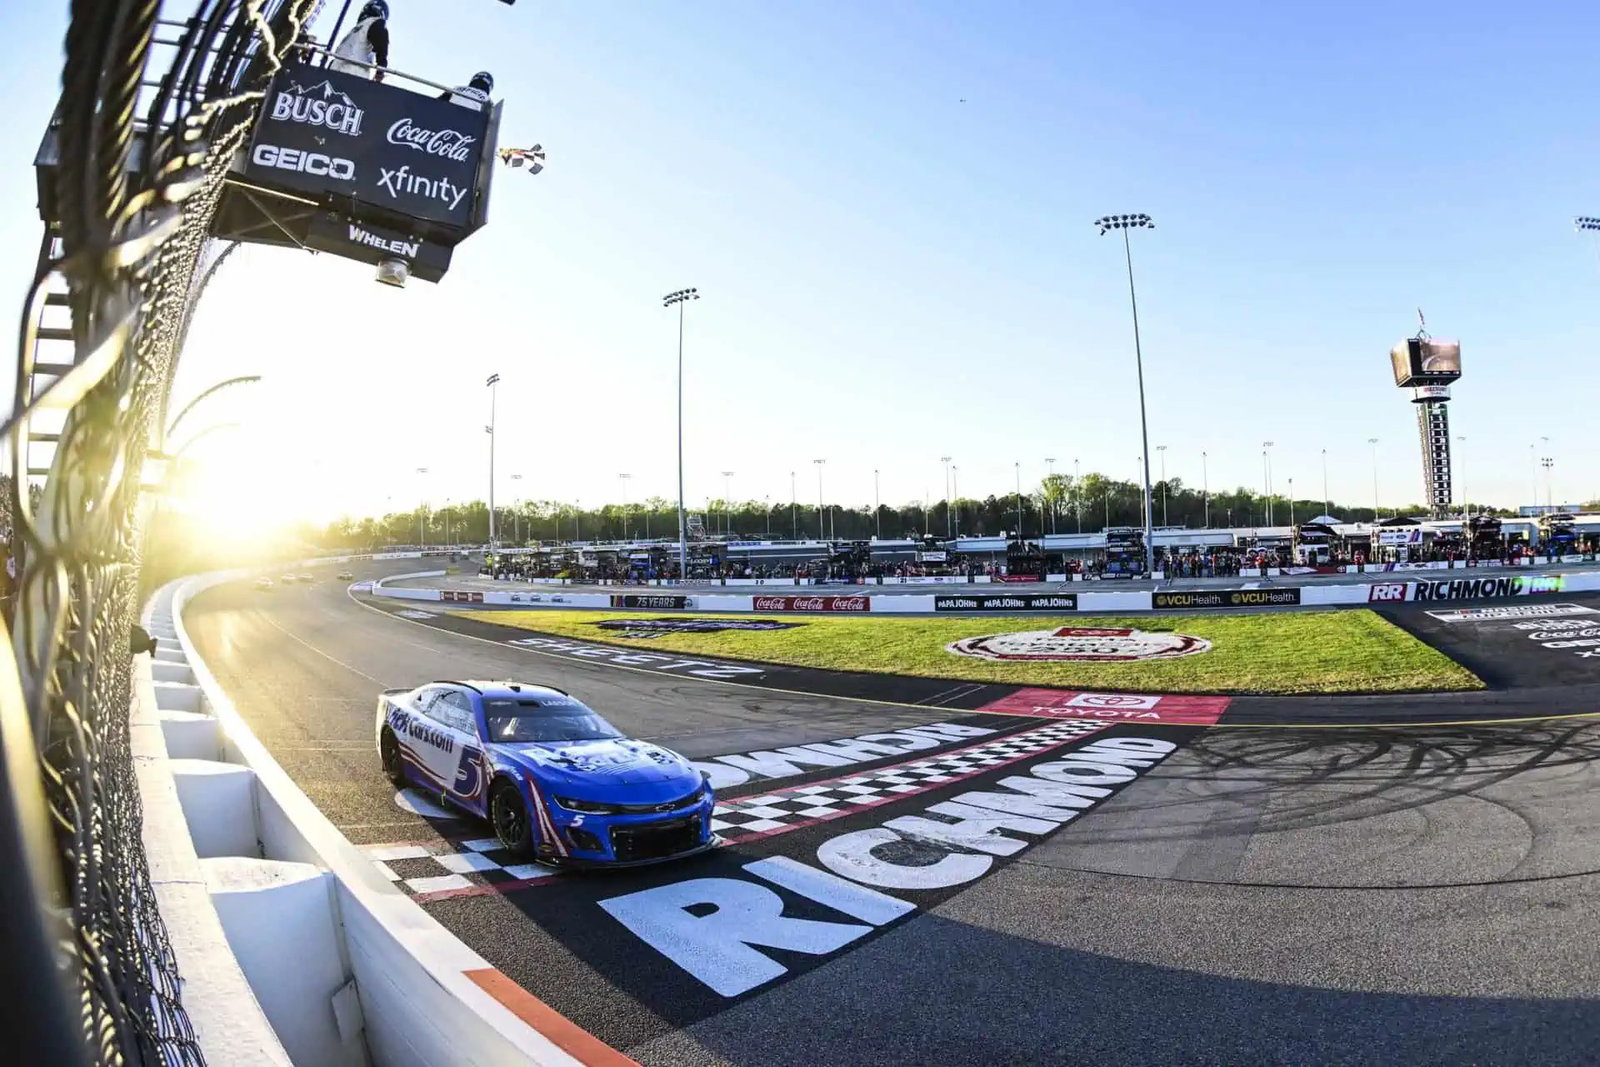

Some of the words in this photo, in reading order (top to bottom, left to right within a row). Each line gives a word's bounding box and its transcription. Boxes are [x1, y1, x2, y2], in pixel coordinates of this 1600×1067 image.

[270, 92, 364, 136] BUSCH
[387, 118, 476, 161] Coca-Cola
[253, 144, 355, 180] GEICO
[376, 166, 467, 210] xfinity
[349, 224, 420, 258] WHELEN
[636, 597, 647, 607] 75
[647, 597, 675, 607] YEARS
[1372, 584, 1403, 600] RR
[1413, 577, 1523, 601] RICHMOND
[1033, 705, 1161, 719] TOYOTA
[570, 815, 586, 827] 5
[597, 736, 1177, 998] RICHMOND
